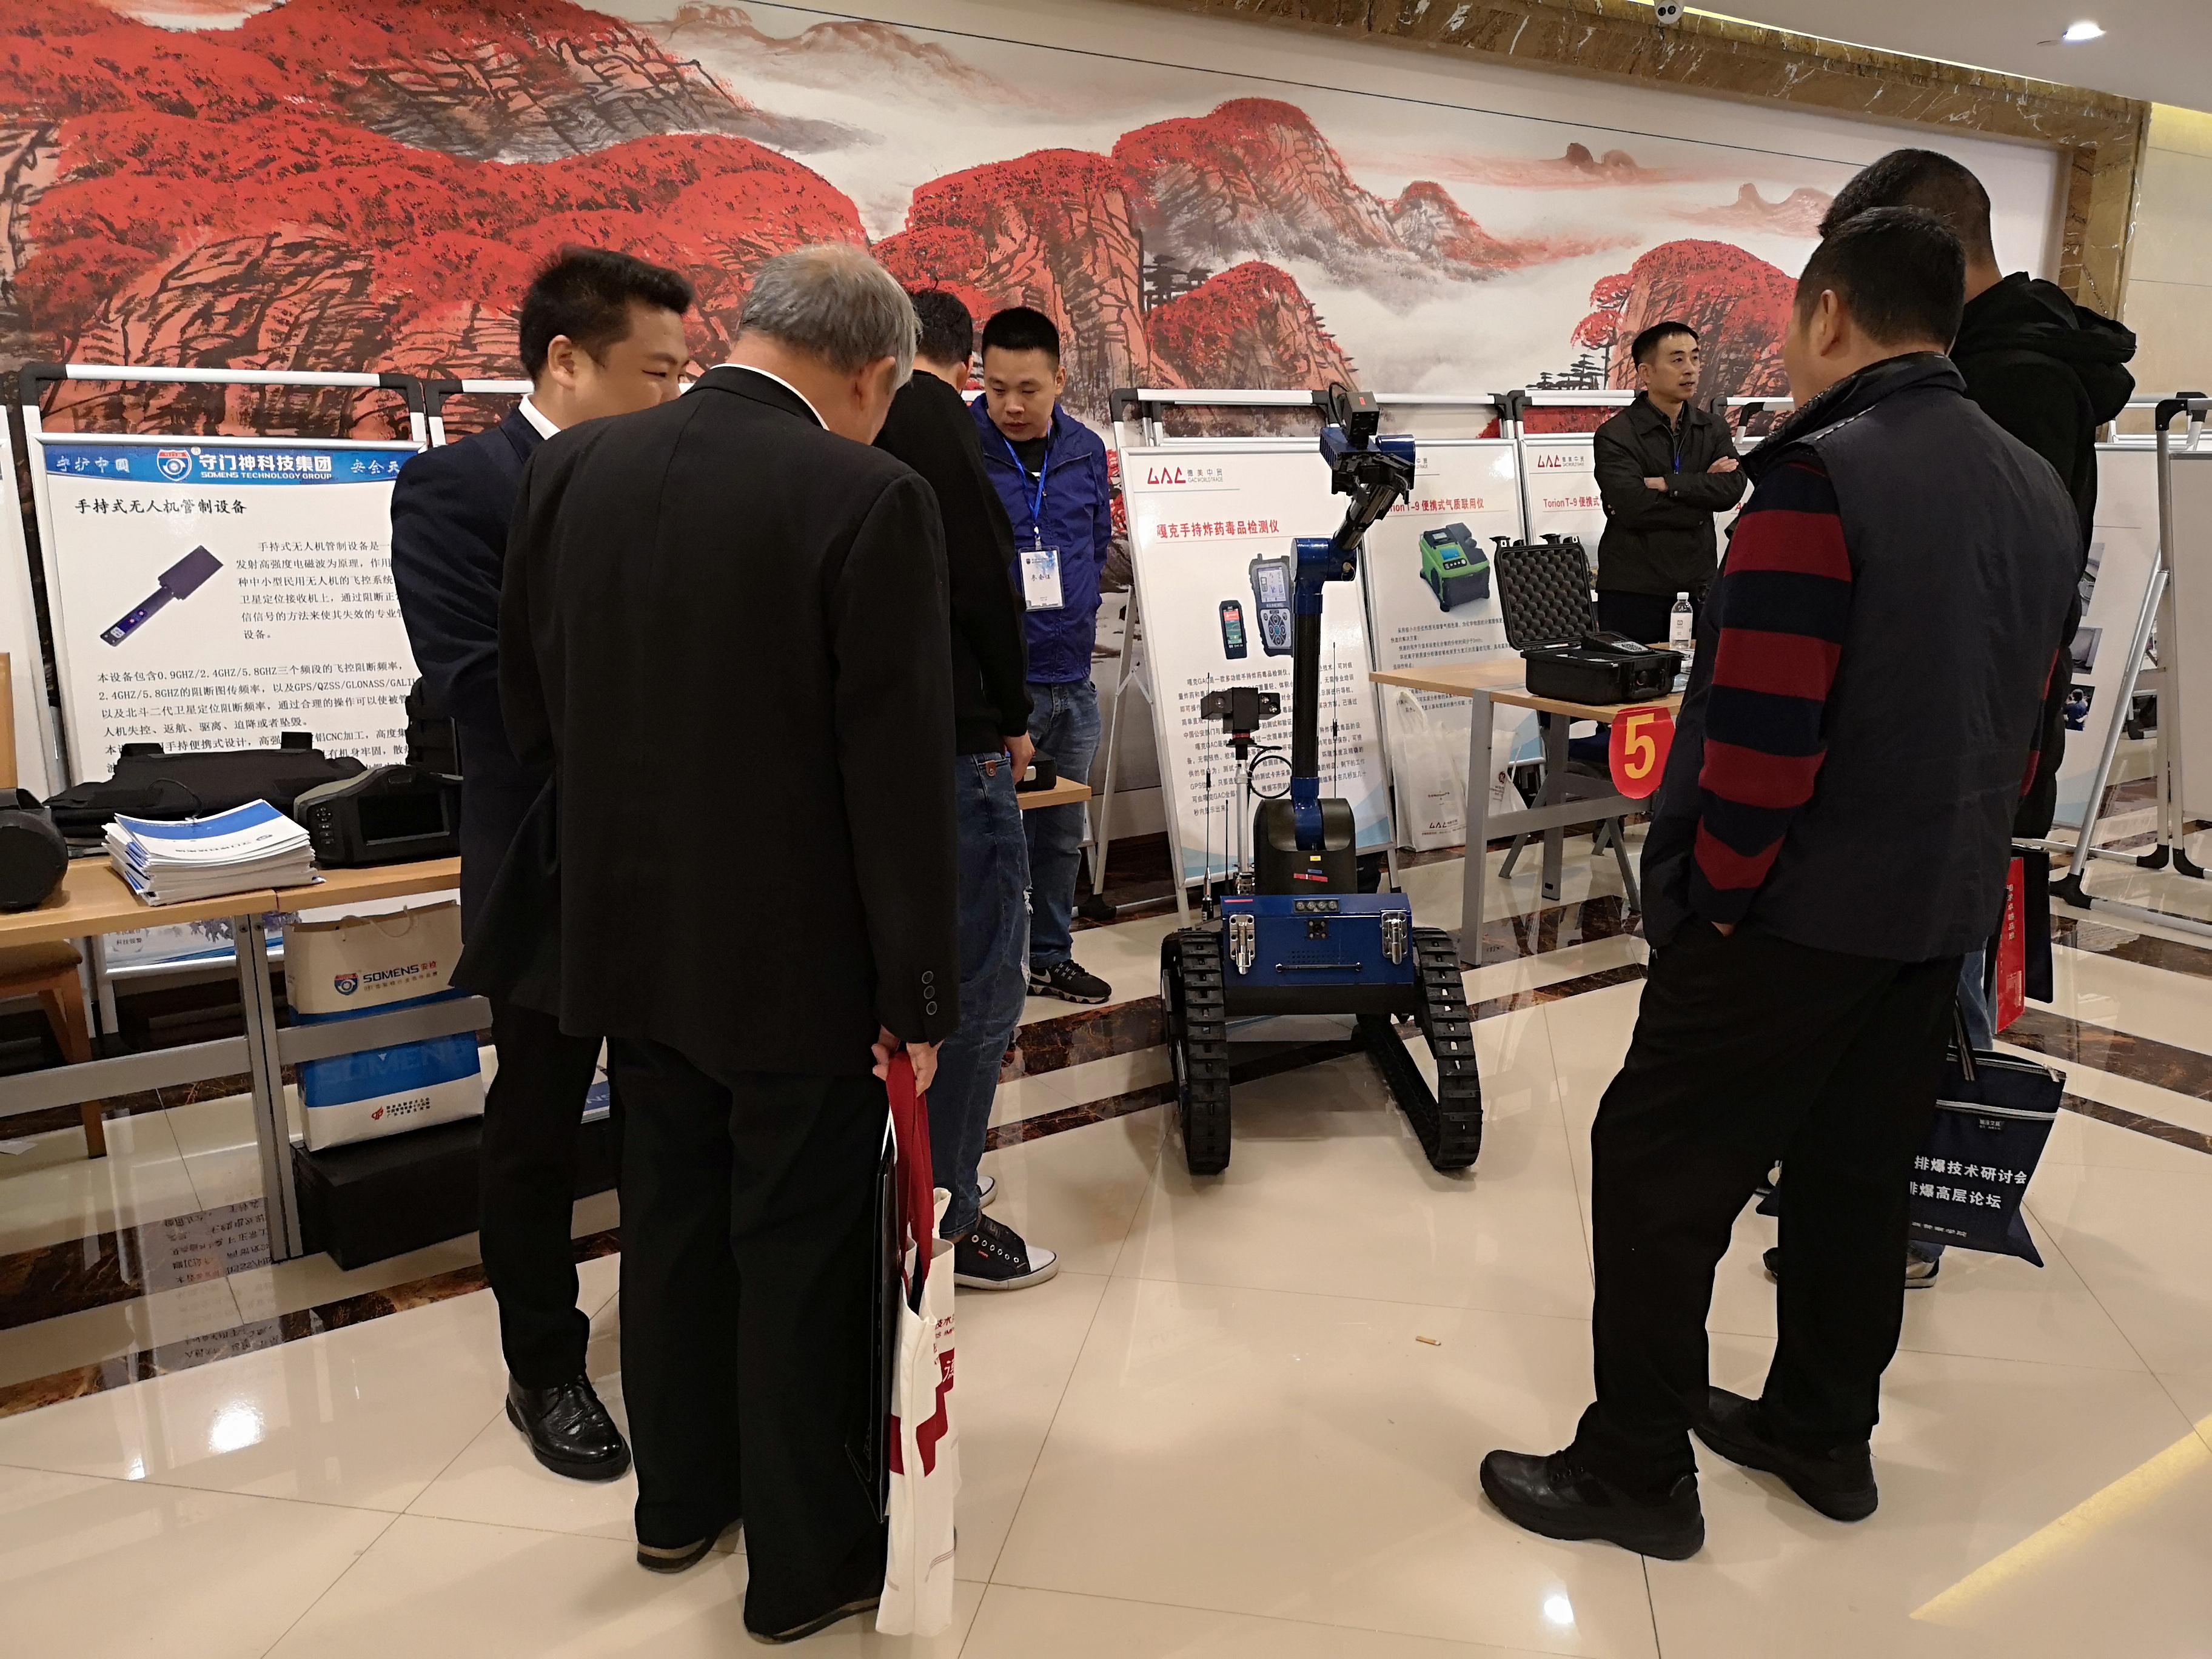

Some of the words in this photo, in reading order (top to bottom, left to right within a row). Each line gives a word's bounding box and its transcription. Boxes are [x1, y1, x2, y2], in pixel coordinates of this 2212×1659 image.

[56, 455, 130, 473] 守护中国
[199, 454, 332, 472] 守门神科技集团
[75, 498, 247, 514] 手持式无人机管制设备
[1422, 498, 1484, 512] 便携式气质联用仪
[1543, 498, 1564, 508] Torion
[1565, 498, 1577, 506] T-9
[1579, 496, 1600, 507] 便携式
[1156, 520, 1279, 538] 嘎克手持炸药毒品检测仪
[258, 541, 390, 552] 手持式无人机管制设备是一
[238, 574, 393, 587] 种中小型民用无人机的飞控系统
[243, 630, 271, 640] 设备。
[1624, 713, 1655, 779] 5
[363, 965, 419, 983] SOMENS
[1914, 1155, 2028, 1184] 排爆技术研讨会
